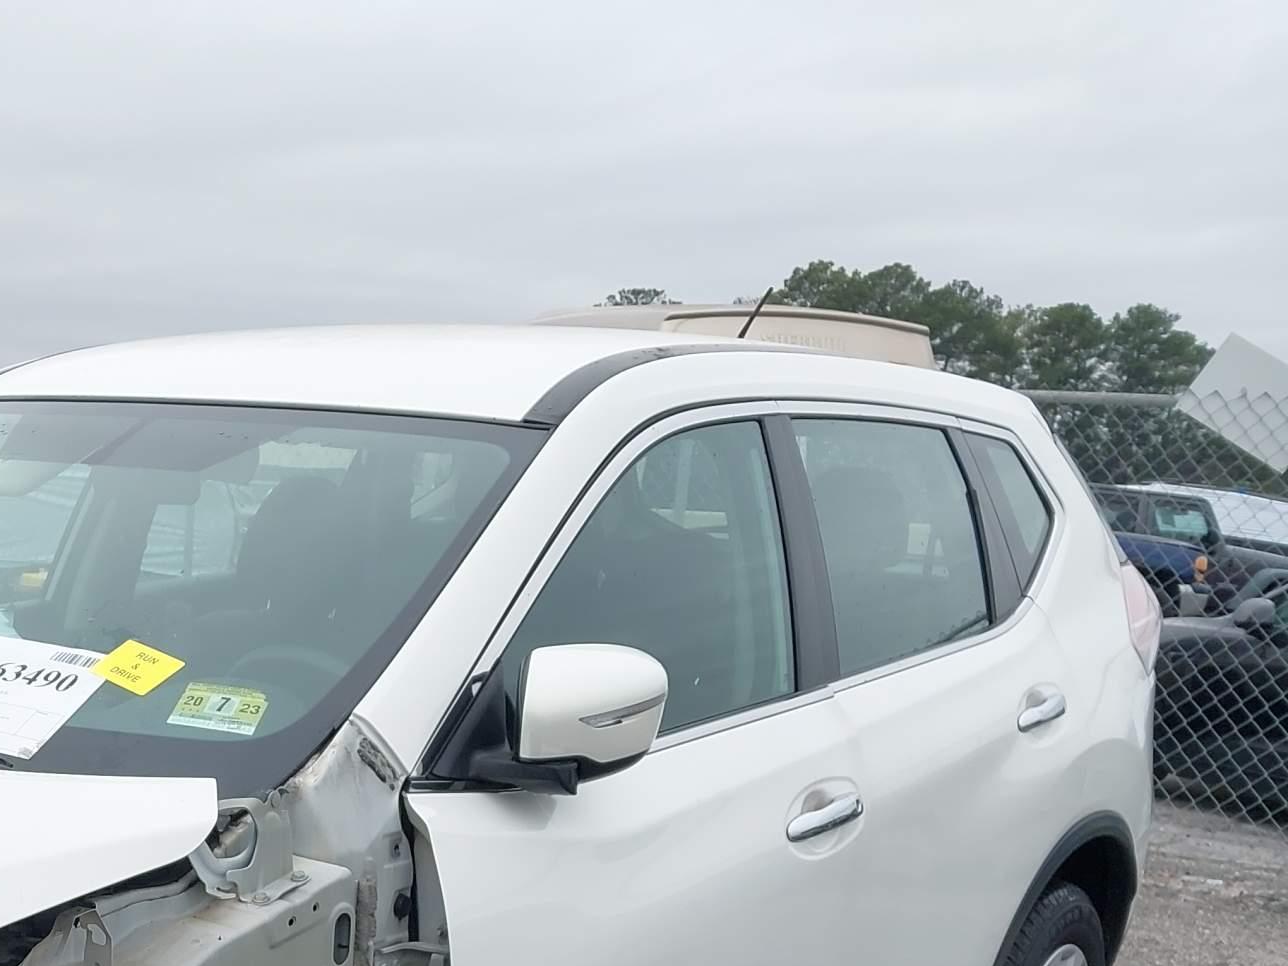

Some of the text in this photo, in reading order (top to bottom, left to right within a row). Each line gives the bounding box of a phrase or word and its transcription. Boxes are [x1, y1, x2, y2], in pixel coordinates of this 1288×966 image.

[135, 651, 160, 665] RUN
[109, 665, 142, 683] DRIVE
[183, 695, 261, 715] 20 7 23
